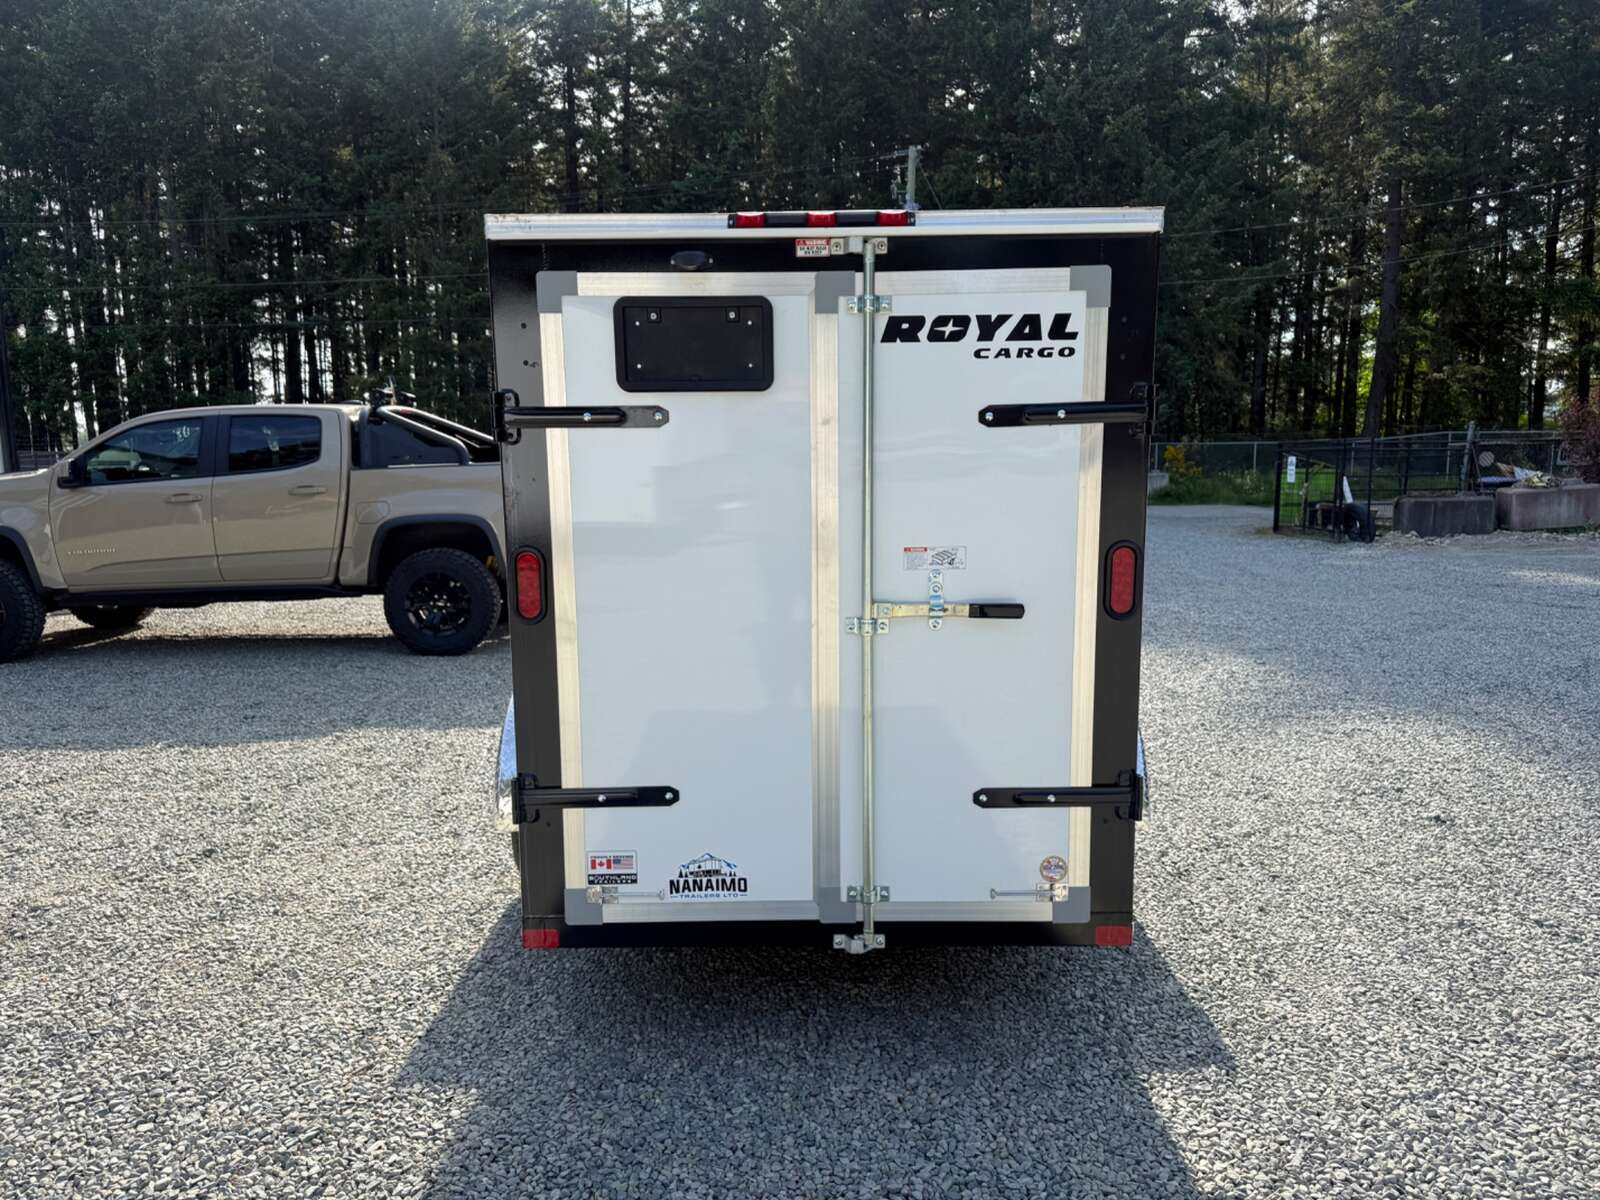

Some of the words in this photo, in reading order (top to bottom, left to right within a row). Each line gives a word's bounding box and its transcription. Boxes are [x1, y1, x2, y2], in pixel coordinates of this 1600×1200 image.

[880, 313, 1079, 343] ROYAL
[973, 346, 1076, 359] CARGO
[669, 877, 748, 895] NANAIMO
